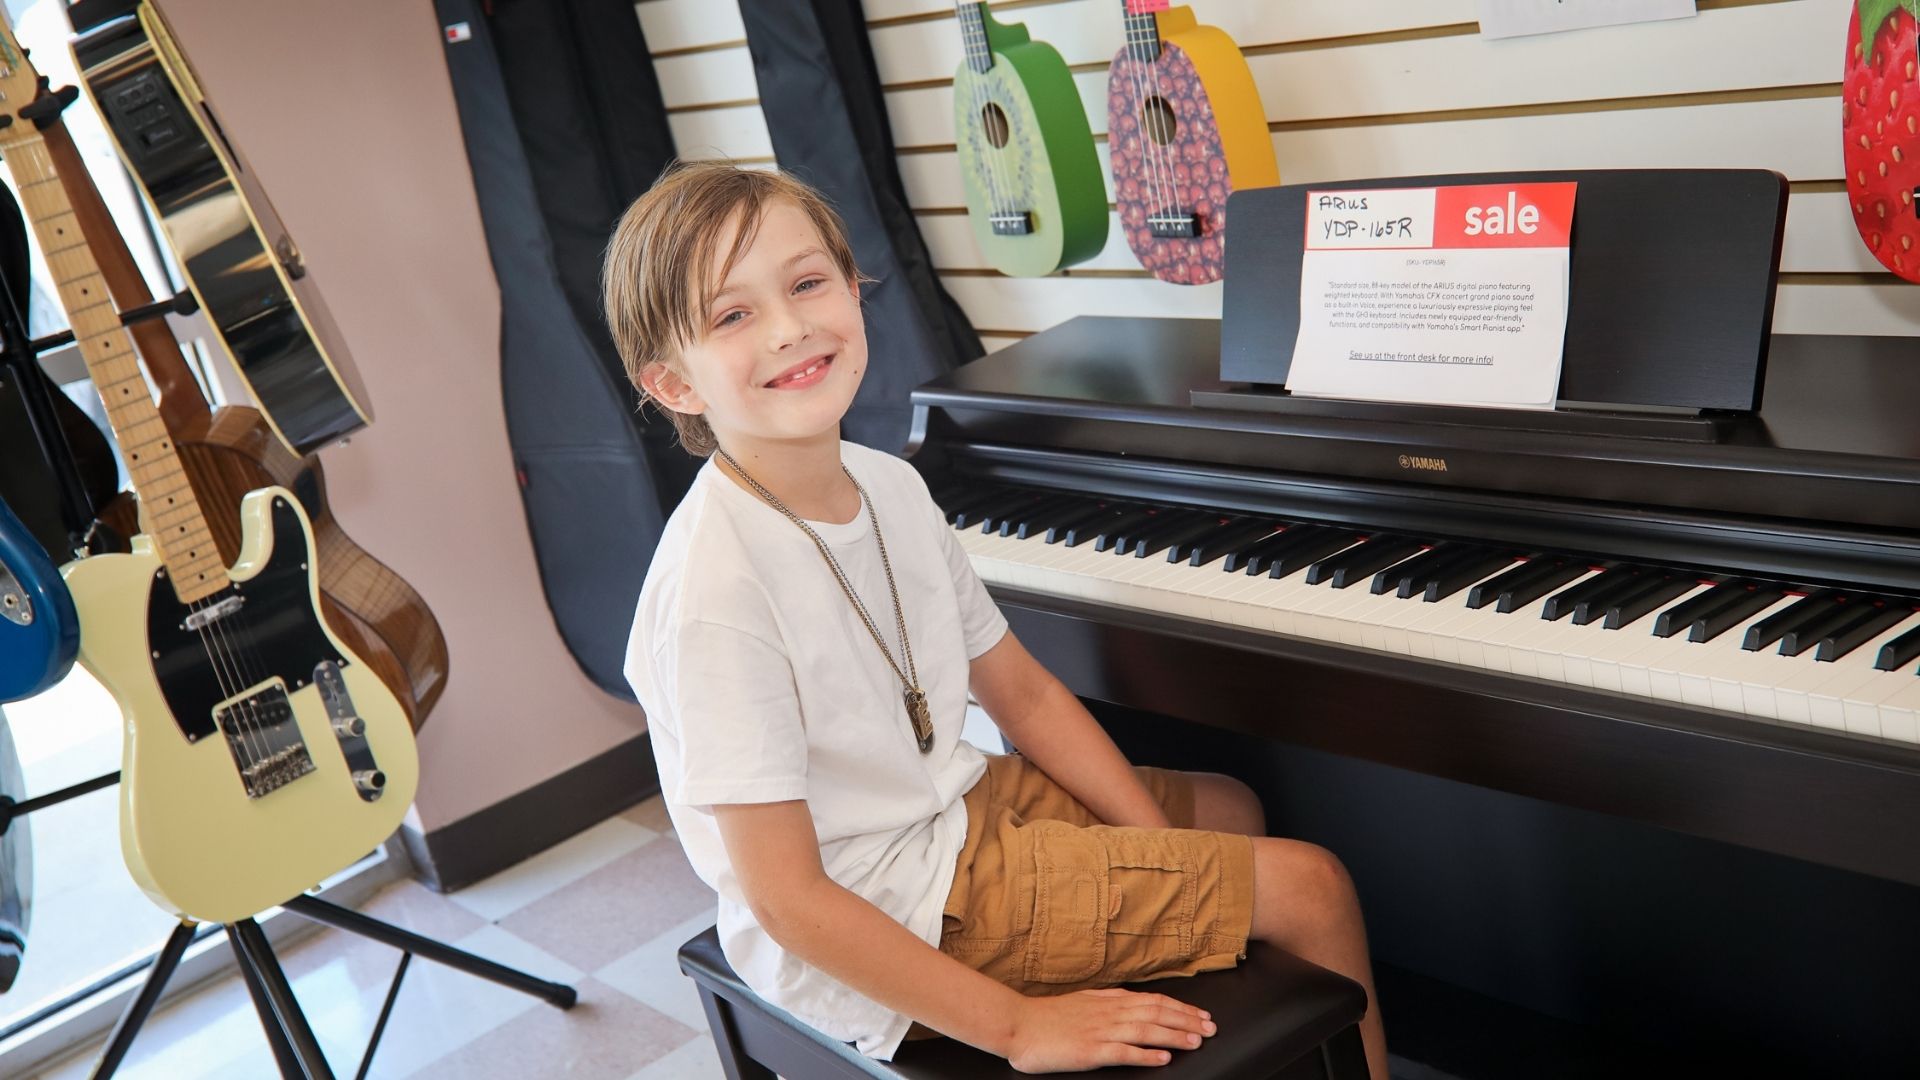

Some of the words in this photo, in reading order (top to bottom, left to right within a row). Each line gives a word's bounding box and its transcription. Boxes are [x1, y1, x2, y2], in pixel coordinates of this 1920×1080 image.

[1464, 191, 1540, 236] sale
[1323, 216, 1414, 240] YDP-165R
[1456, 282, 1476, 291] digital
[1478, 283, 1497, 291] piano
[1498, 282, 1531, 292] featuring
[1324, 292, 1350, 300] weighted
[1469, 294, 1490, 302] grand
[1491, 294, 1511, 302] piano
[1418, 303, 1456, 311] luxuriously
[1493, 304, 1519, 313] playing
[1428, 313, 1447, 321] newly
[1448, 314, 1481, 322] equipped
[1482, 314, 1522, 324] ear-friendly
[1359, 321, 1370, 329] and
[1371, 322, 1410, 331] compatibility
[1426, 323, 1459, 331] Yamaha's
[1482, 324, 1506, 332] Pianist
[1349, 350, 1362, 360] See
[1374, 353, 1382, 361] at
[1384, 353, 1396, 361] the
[1397, 353, 1416, 362] front
[1417, 354, 1437, 363] desk
[1438, 354, 1450, 364] for
[1452, 356, 1474, 364] more
[1475, 355, 1494, 365] info!
[1409, 456, 1448, 472] YAMAHA
